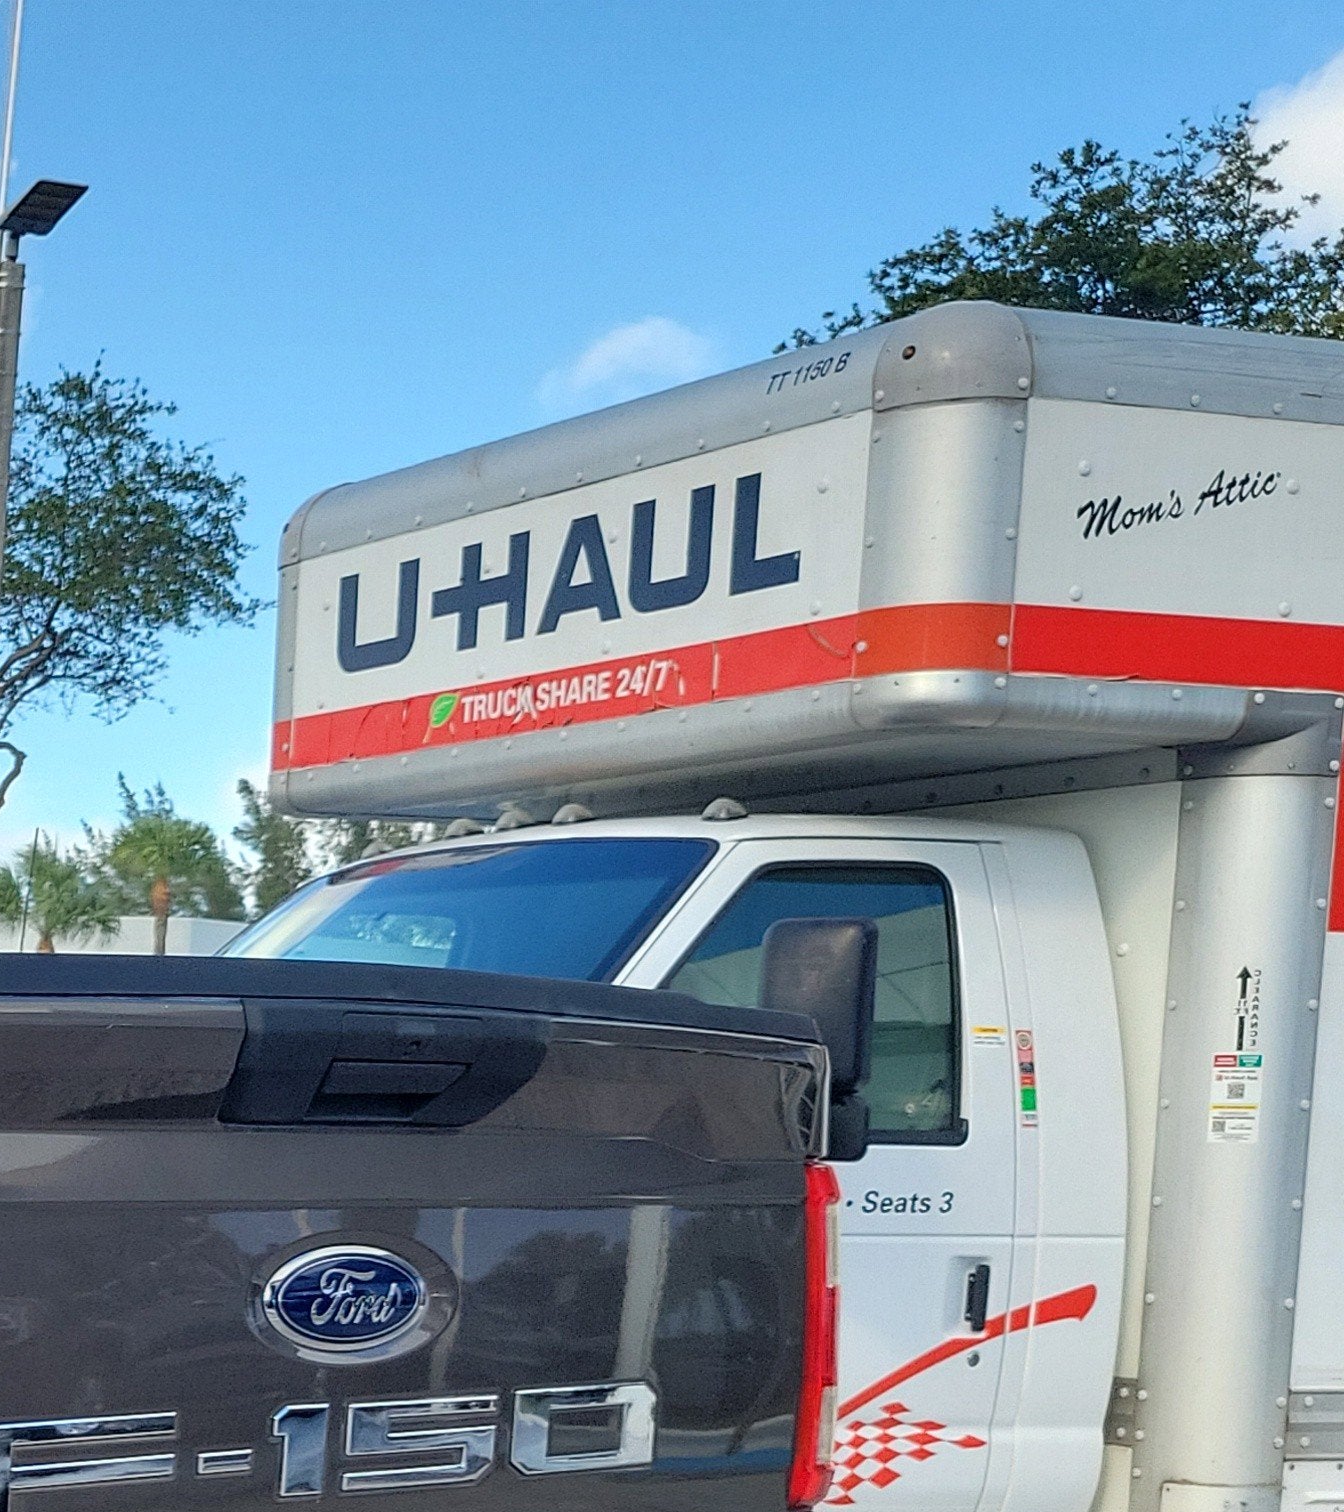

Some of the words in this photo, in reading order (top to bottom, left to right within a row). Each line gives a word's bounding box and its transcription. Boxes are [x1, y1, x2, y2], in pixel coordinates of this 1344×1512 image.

[766, 370, 792, 395] TT
[1077, 489, 1183, 539] Mom's
[1194, 469, 1277, 516] Attic
[337, 473, 801, 675] U-HAUL
[535, 670, 612, 714] SHARE
[862, 1190, 932, 1213] Seats
[939, 1191, 954, 1213] 3
[310, 1268, 403, 1325] Ford
